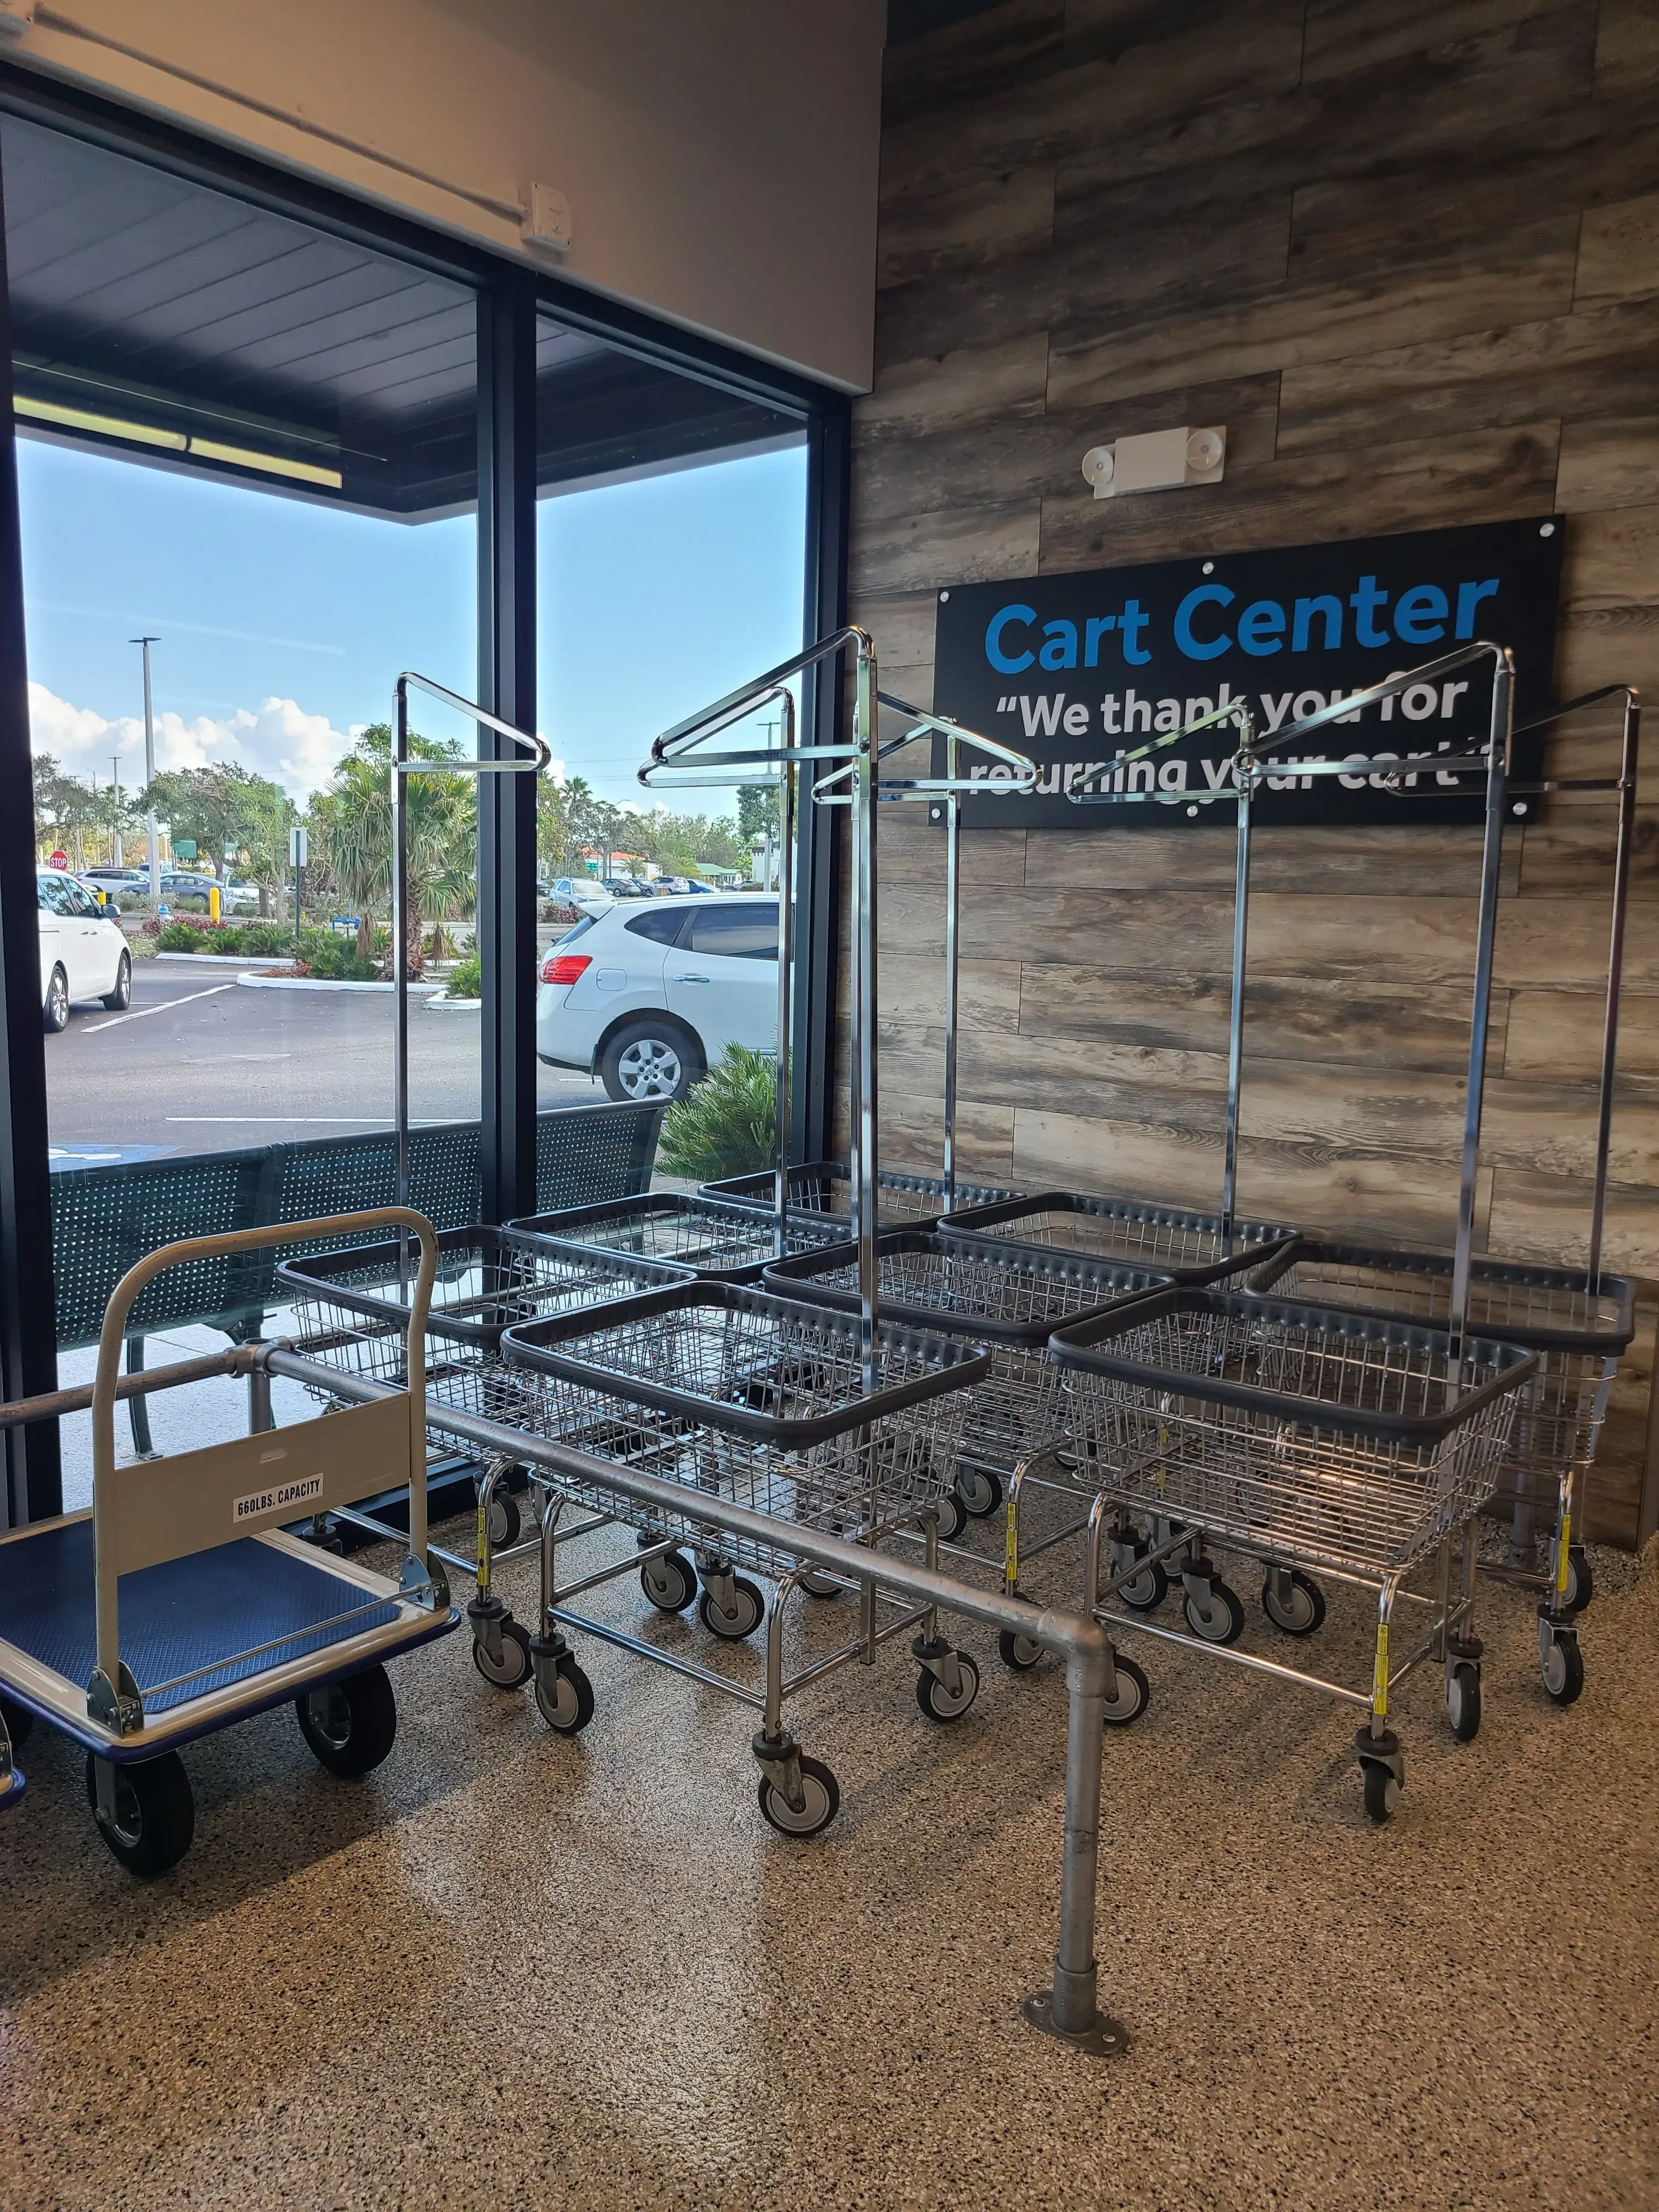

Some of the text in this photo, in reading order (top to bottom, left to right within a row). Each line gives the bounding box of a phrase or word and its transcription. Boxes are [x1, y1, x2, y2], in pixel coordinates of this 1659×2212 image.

[985, 575, 1499, 674] Cart Center
[1101, 684, 1247, 732] thank
[1257, 687, 1363, 738] you
[1380, 671, 1469, 721] for
[969, 750, 1188, 805] returning
[50, 857, 66, 868] STOP
[238, 1479, 320, 1516] 660LBS. CAPACITY
